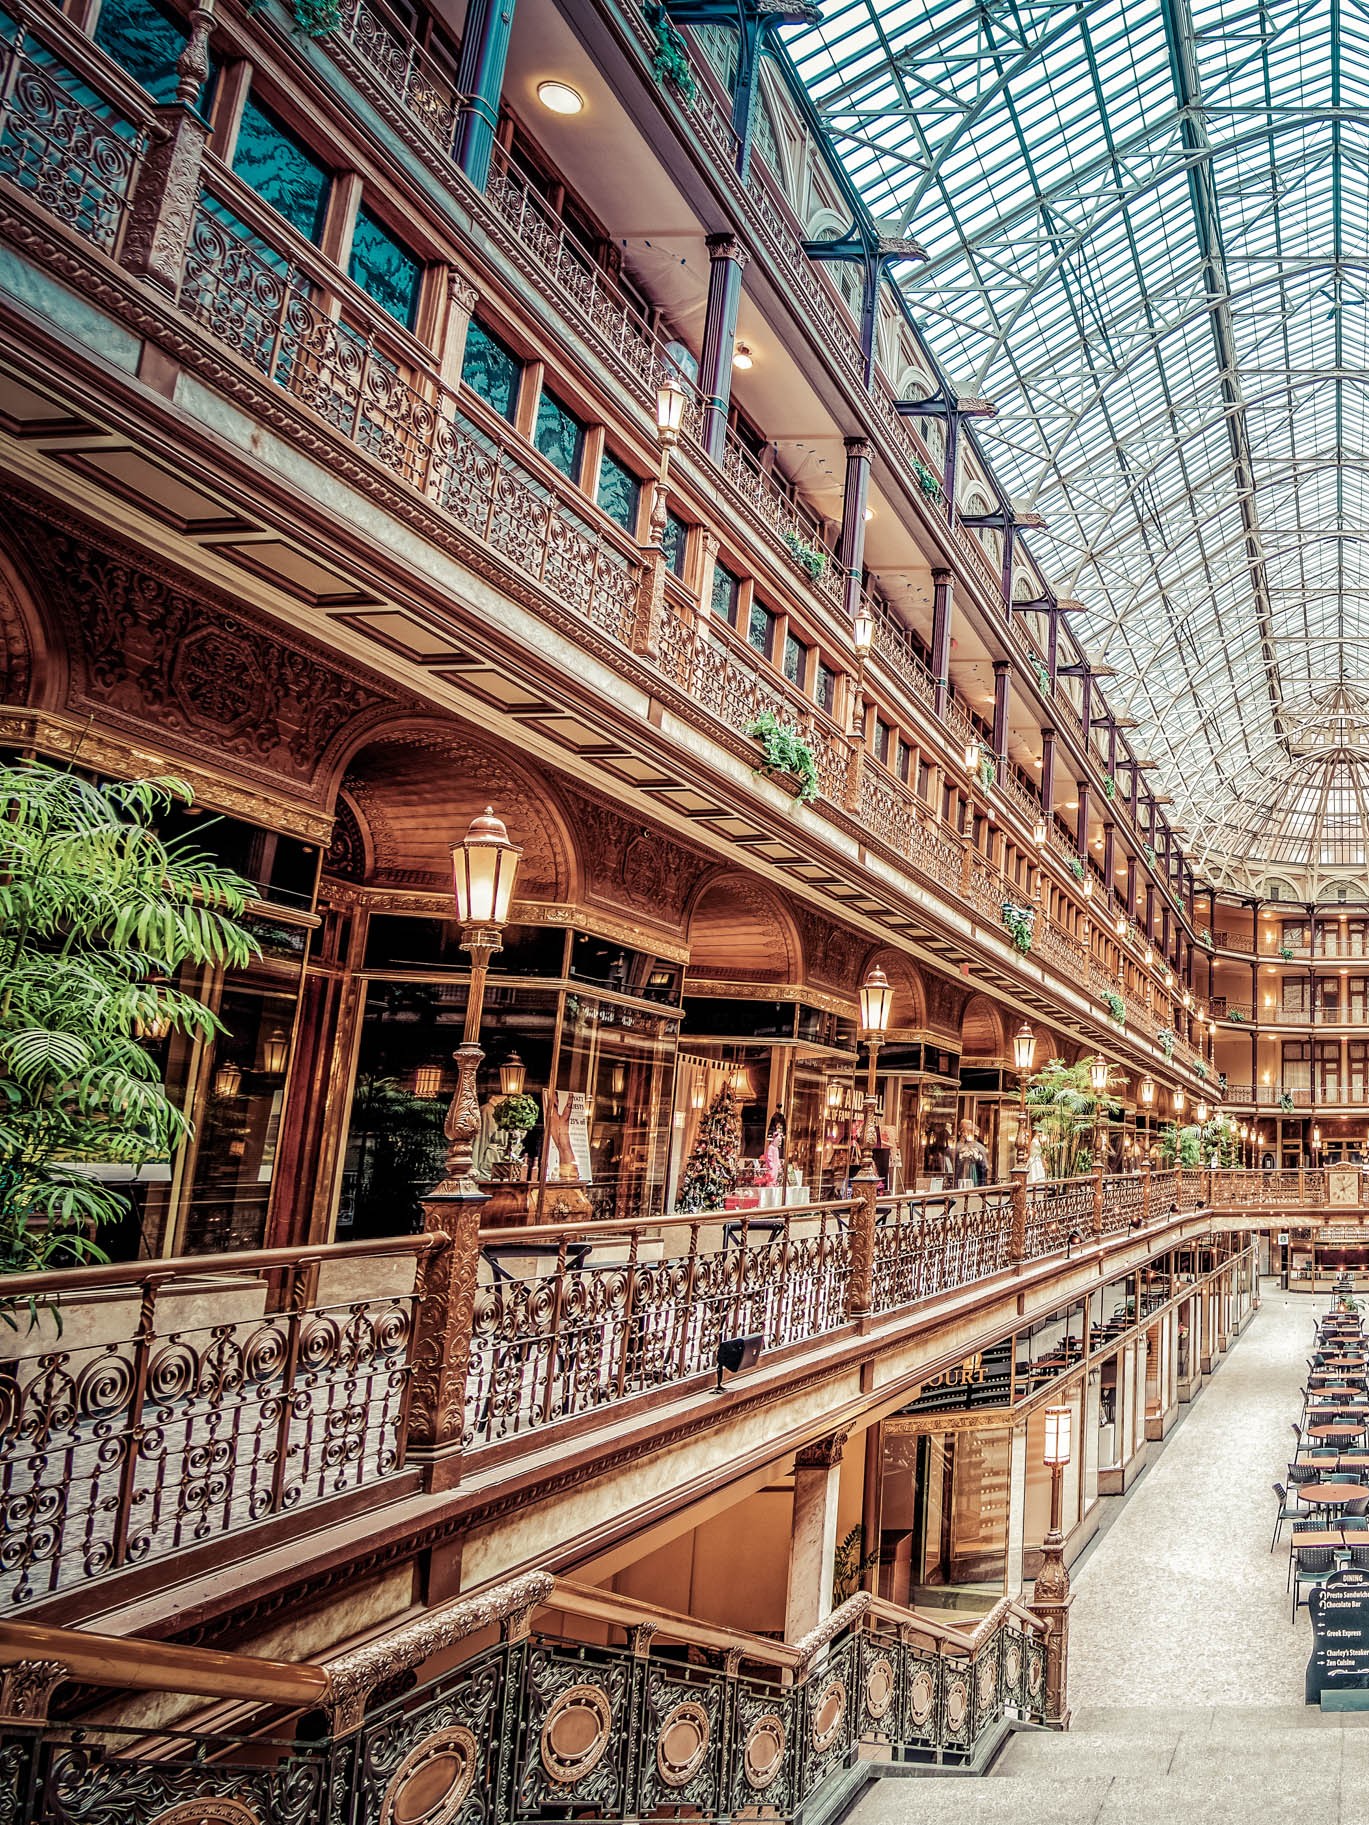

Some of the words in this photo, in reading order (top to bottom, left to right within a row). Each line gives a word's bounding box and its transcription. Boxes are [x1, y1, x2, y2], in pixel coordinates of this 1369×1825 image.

[928, 1367, 989, 1387] OURT
[1343, 1574, 1363, 1582] DINING
[1342, 1630, 1362, 1638] Express
